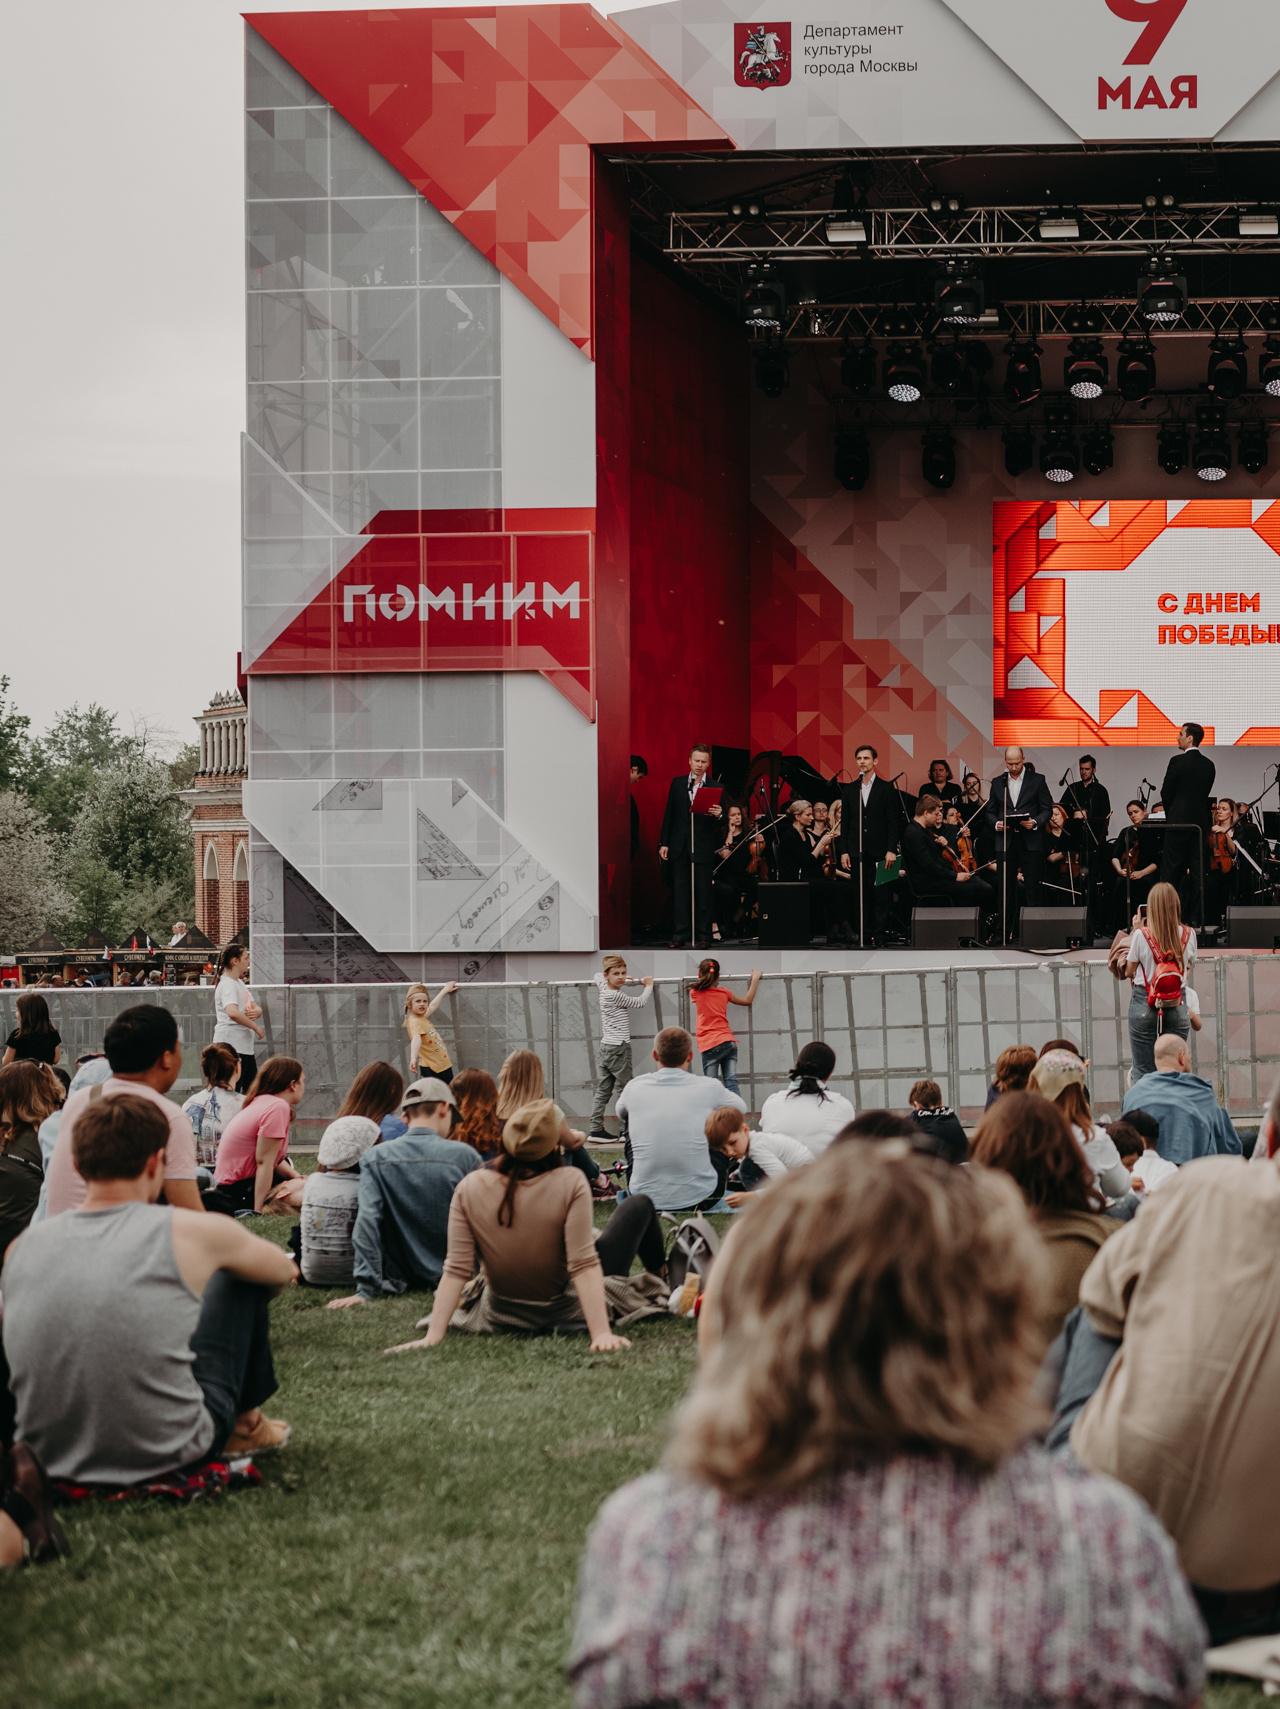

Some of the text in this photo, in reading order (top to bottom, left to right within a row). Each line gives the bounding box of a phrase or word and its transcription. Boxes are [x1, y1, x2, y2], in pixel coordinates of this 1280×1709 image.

[803, 24, 904, 40] Департамент
[804, 44, 872, 59] культуры
[804, 60, 918, 77] города Москвы
[1098, 75, 1198, 110] МАЯ
[343, 581, 580, 622] ПОМНИМ
[1157, 592, 1261, 615] С ДНЕМ
